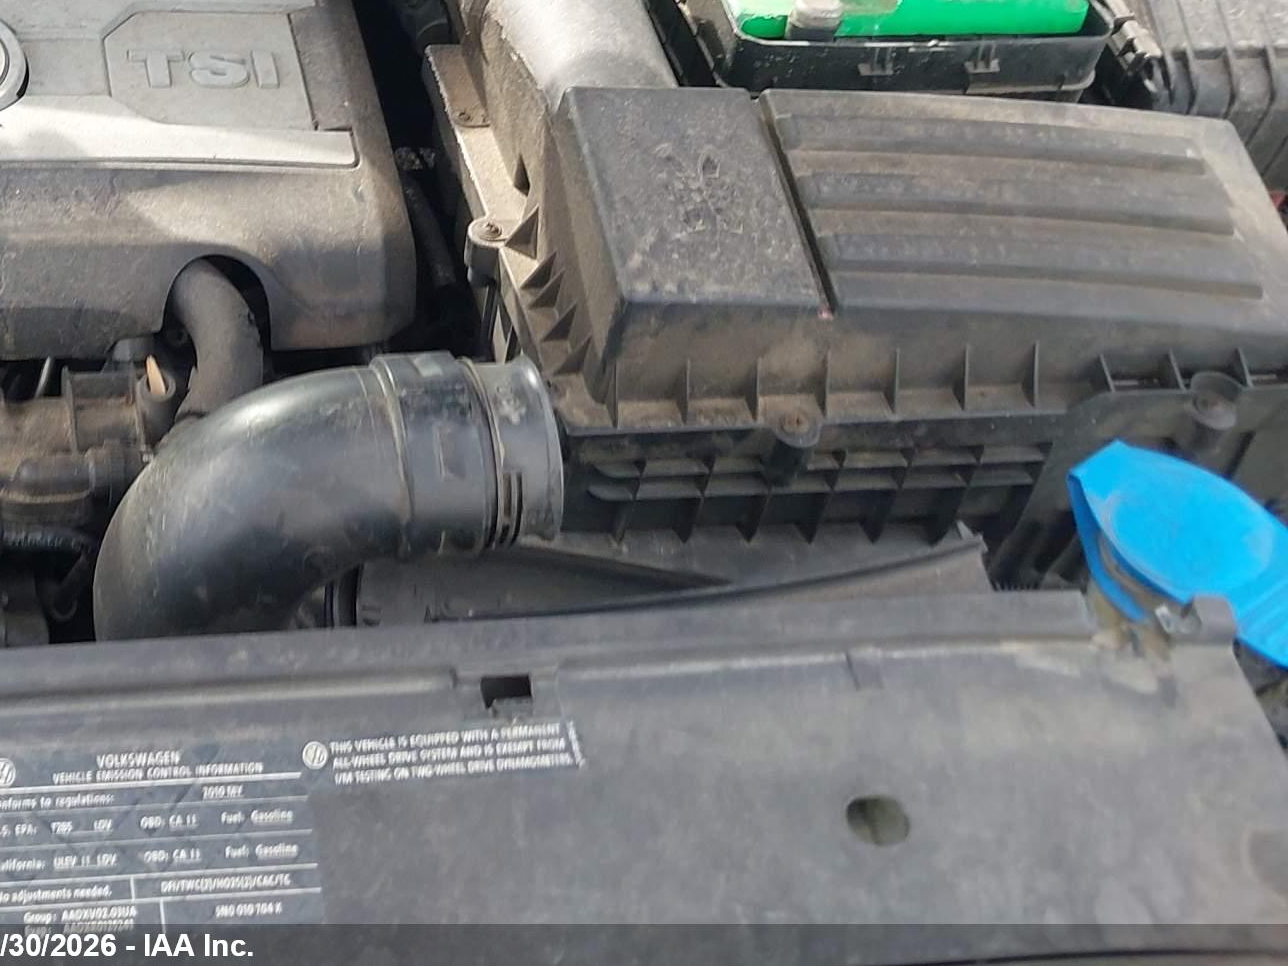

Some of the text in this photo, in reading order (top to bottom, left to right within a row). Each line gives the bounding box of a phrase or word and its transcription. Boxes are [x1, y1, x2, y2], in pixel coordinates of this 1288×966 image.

[126, 49, 280, 89] TSI
[329, 722, 560, 754] THIS VEHICLE IS EQUIPPED WITH A PERMANENT
[96, 750, 180, 769] VOLKSWAGEN
[388, 750, 418, 765] DRIVE
[419, 747, 458, 762] SYSTEM
[460, 744, 482, 758] AND
[484, 743, 494, 756] IS
[496, 740, 534, 755] EXEMPT
[536, 737, 566, 751] FROM
[52, 761, 264, 784] VEHICLE EMISSION CONTROL INFORMATION
[354, 768, 392, 784] TESTING
[394, 766, 410, 780] ON
[467, 758, 495, 773] DRIVE
[40, 797, 51, 809] to
[250, 808, 294, 823] Gasoline
[255, 843, 298, 858] Gasoline
[11, 888, 72, 905] adjustments
